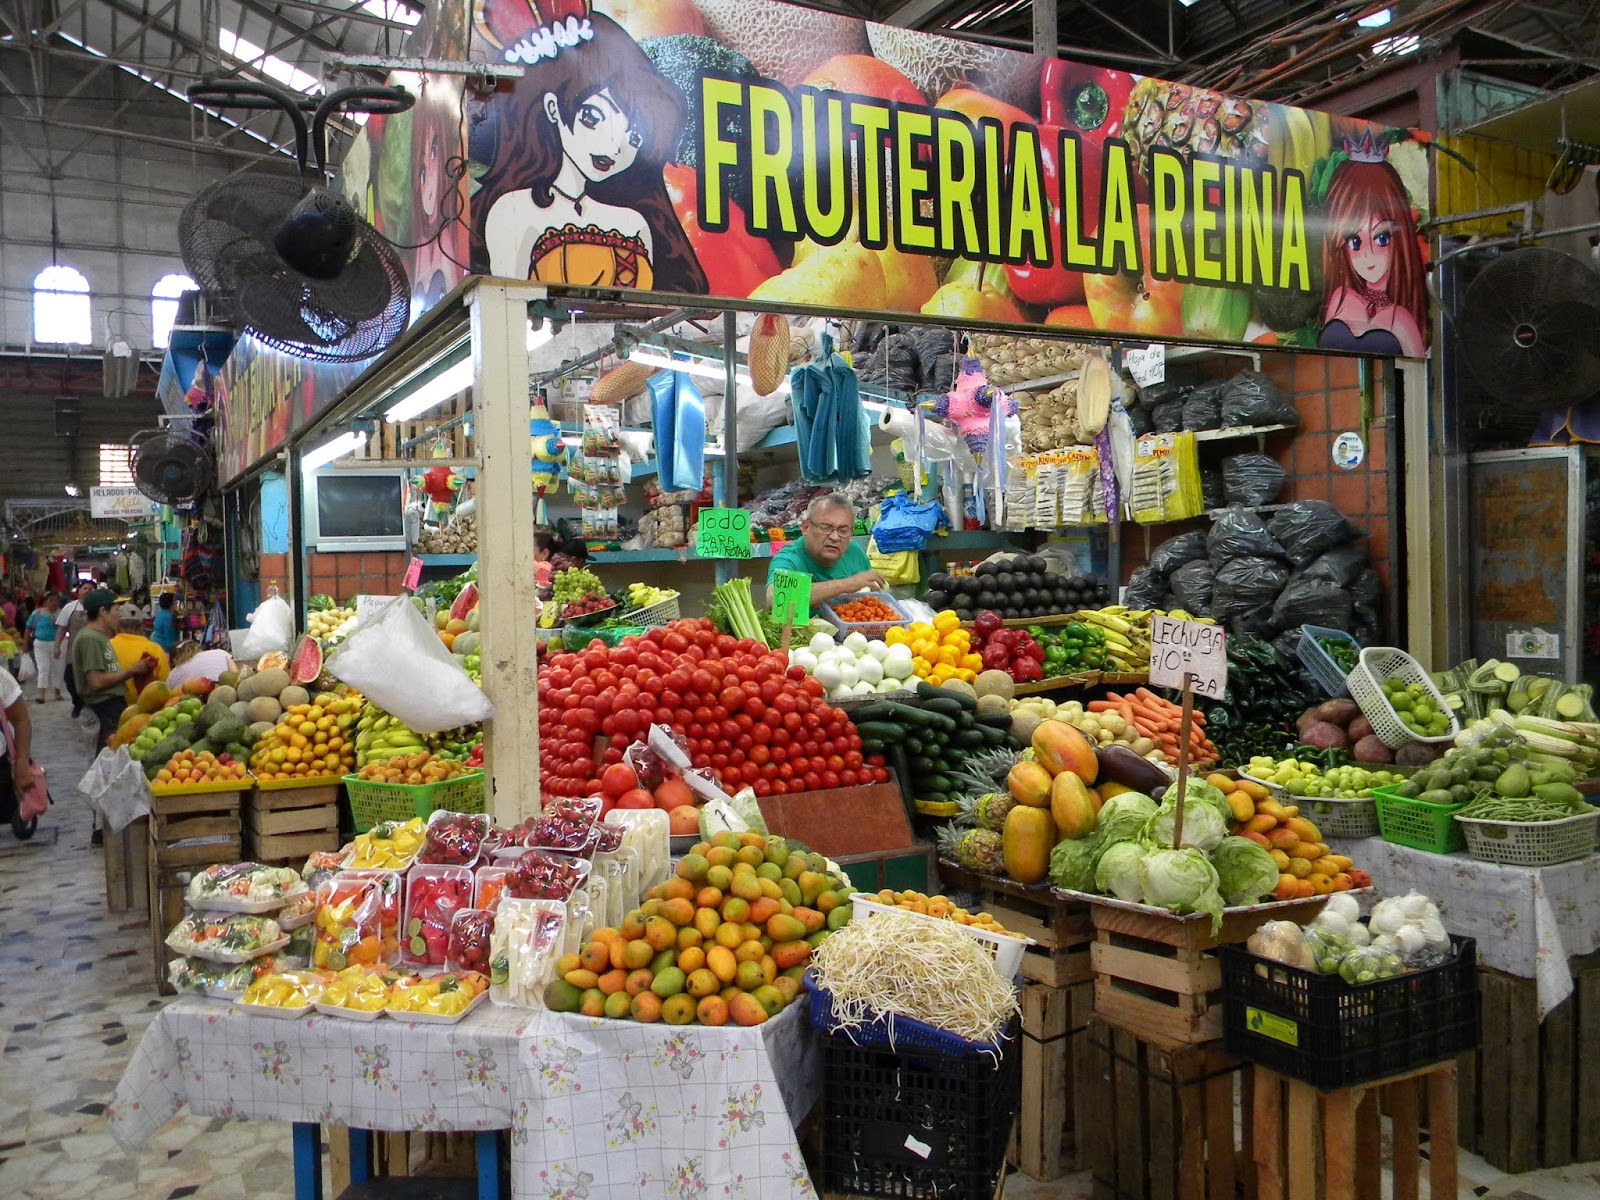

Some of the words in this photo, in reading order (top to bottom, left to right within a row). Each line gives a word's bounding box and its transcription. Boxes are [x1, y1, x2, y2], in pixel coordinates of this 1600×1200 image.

[700, 75, 1049, 263] FRUTERIA
[1062, 136, 1139, 272] LA
[1151, 150, 1311, 293] REINA
[93, 488, 125, 497] HELADOS
[128, 488, 142, 496] PAL
[702, 532, 735, 549] PARA
[774, 572, 798, 588] PEPINO
